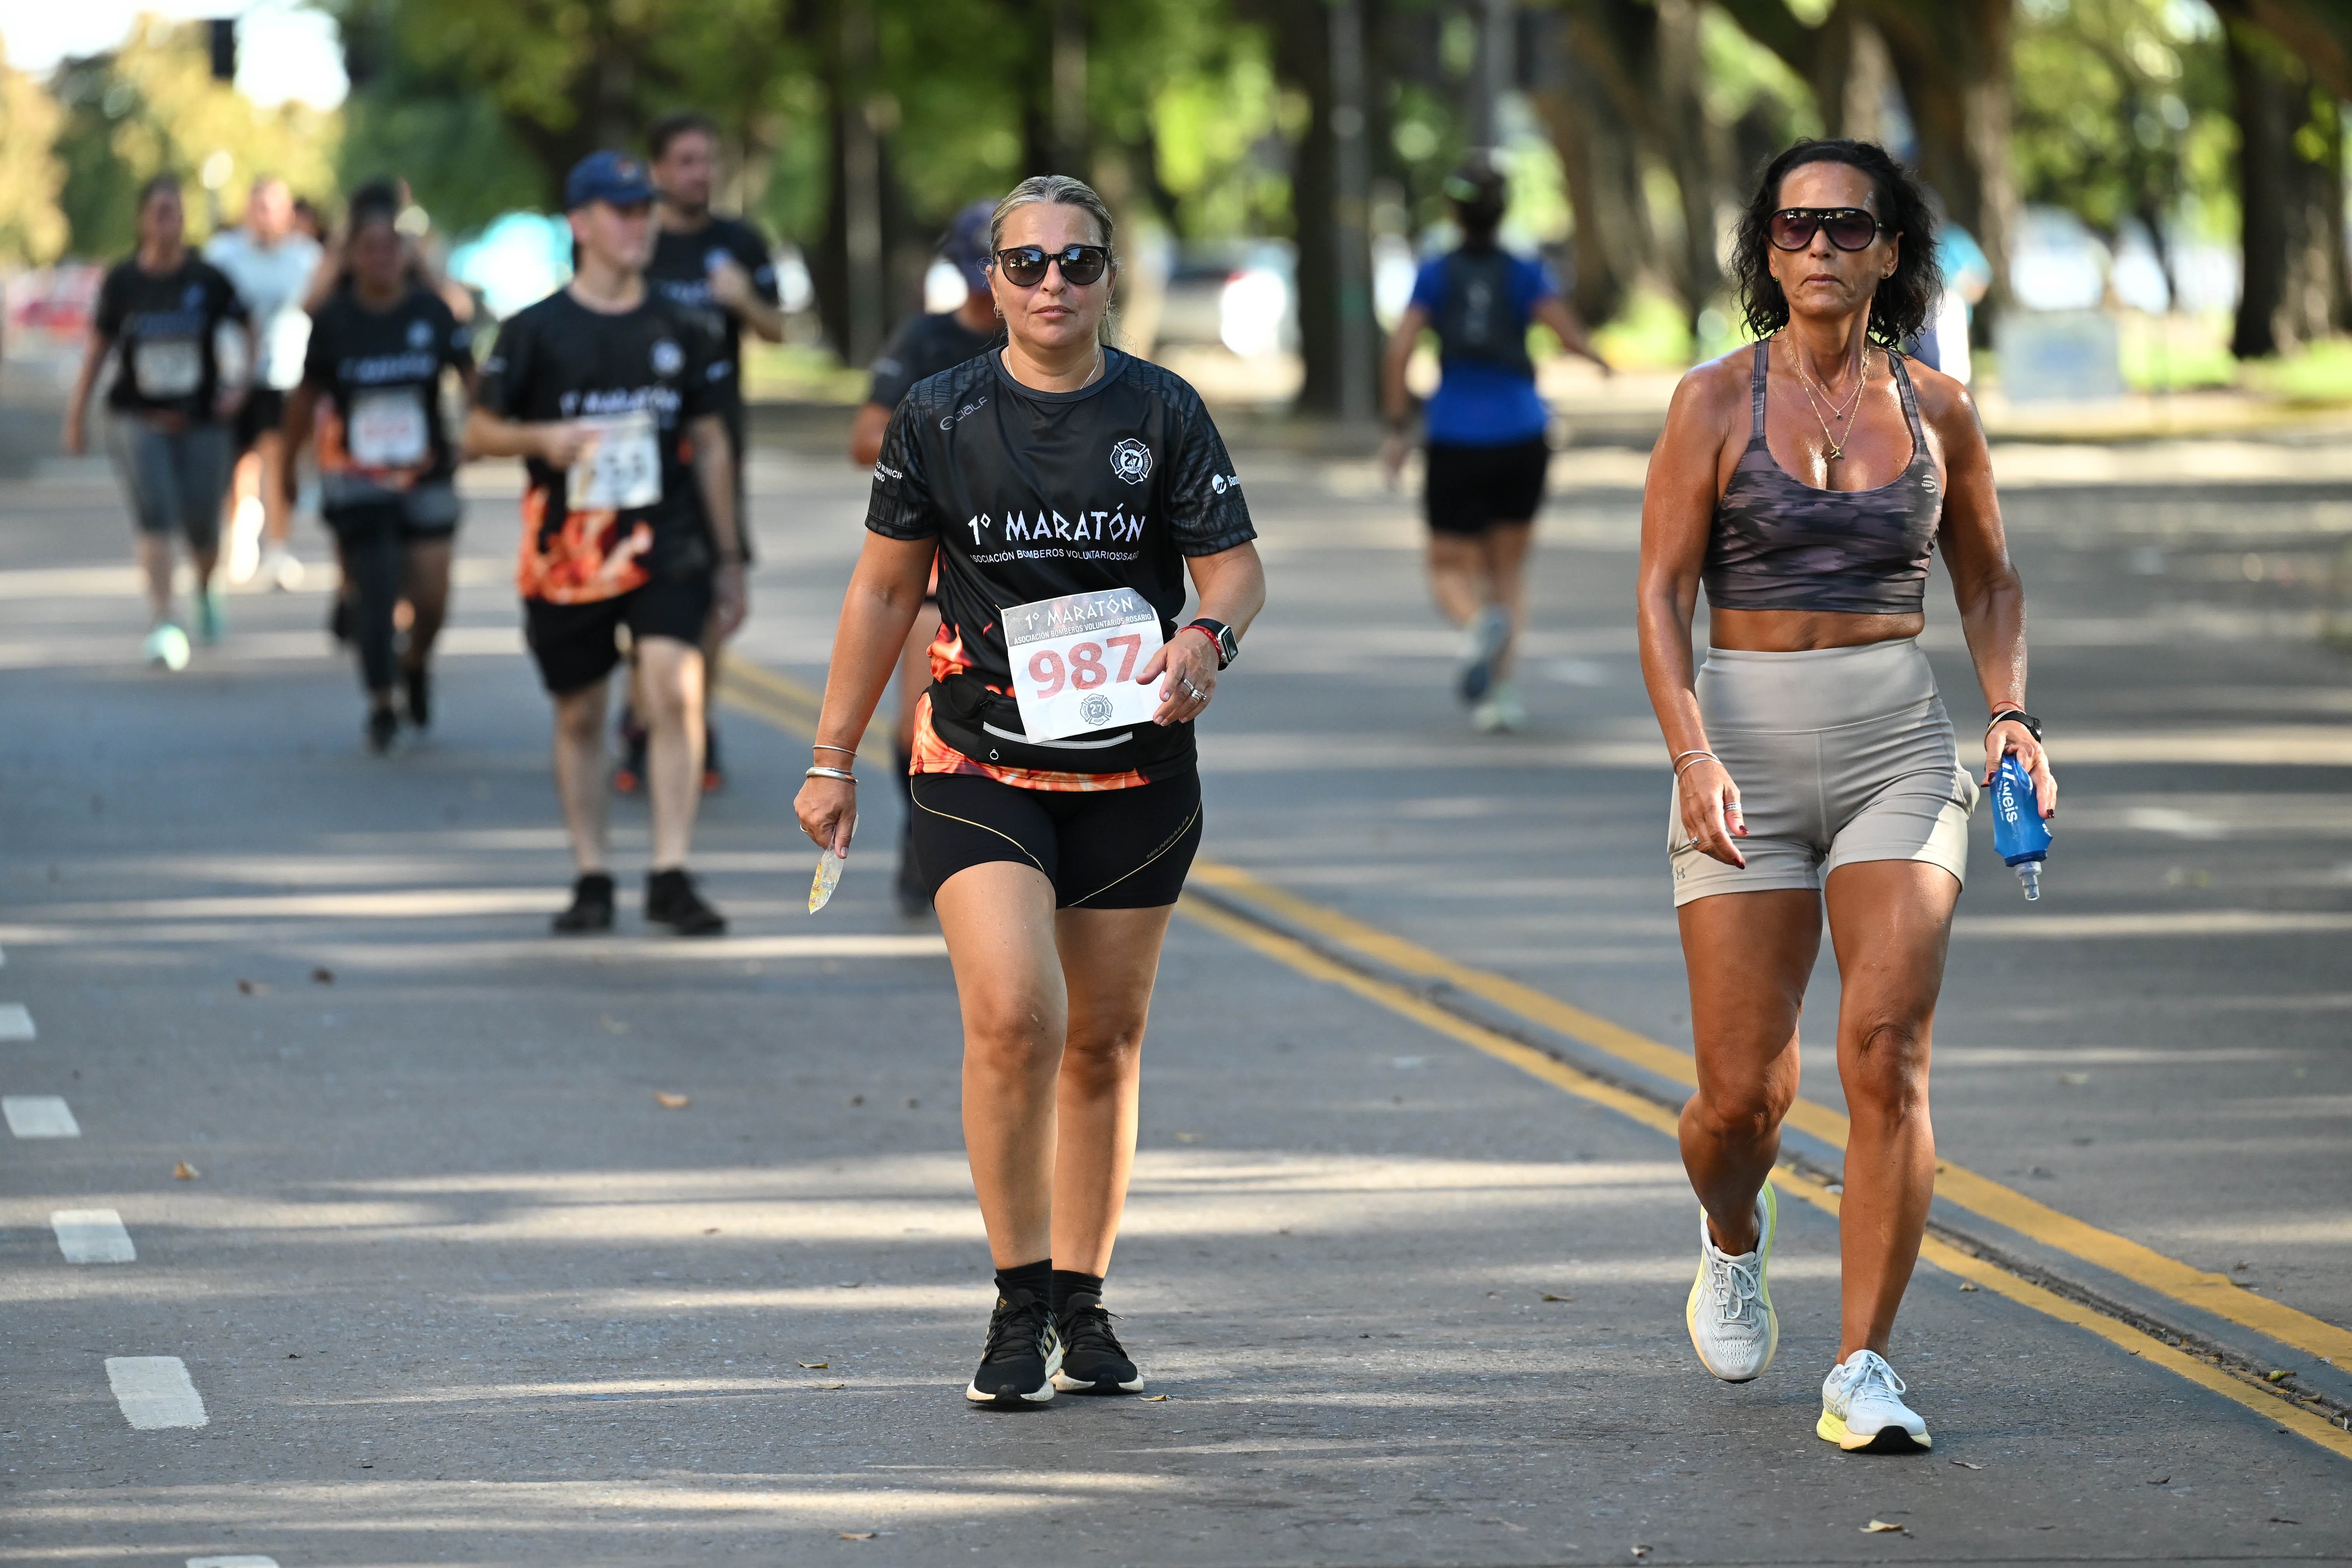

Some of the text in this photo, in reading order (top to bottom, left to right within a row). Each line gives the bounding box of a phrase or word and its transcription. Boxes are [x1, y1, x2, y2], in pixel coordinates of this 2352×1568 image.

[1124, 452, 1140, 467] 27
[1006, 502, 1146, 542] MARATÓN
[1017, 548, 1064, 559] BOMBEROS
[1066, 550, 1120, 561] VOLUNTARIOS
[1047, 594, 1134, 626] MARATÓN
[1014, 613, 1152, 645] ASOCIACIÓN BOMBEROS VOLUNTARIOS ROSARIO
[1028, 634, 1141, 699] 987
[1090, 704, 1102, 715] 27
[2002, 781, 2018, 822] weis
